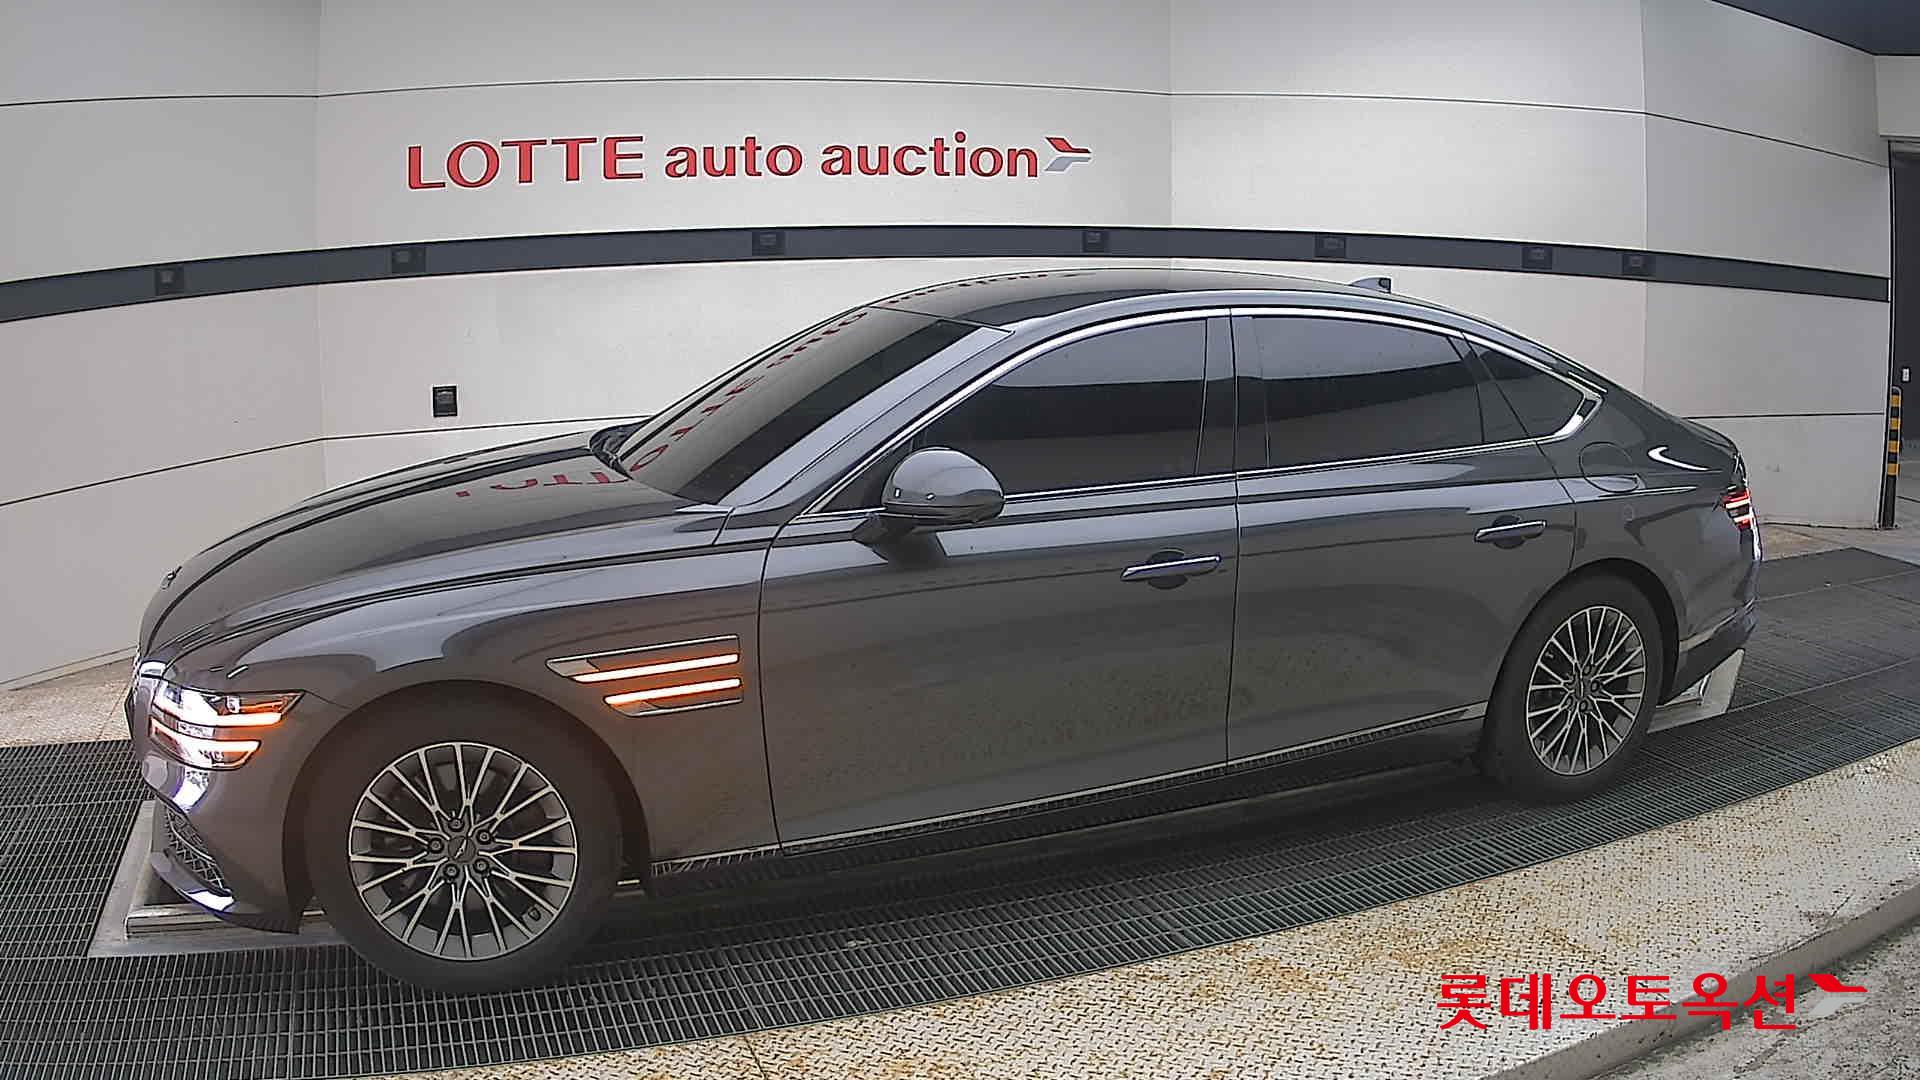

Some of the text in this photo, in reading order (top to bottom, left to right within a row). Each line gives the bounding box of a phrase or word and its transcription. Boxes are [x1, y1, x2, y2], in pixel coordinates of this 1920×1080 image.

[407, 131, 1039, 190] LOTTE auto auction
